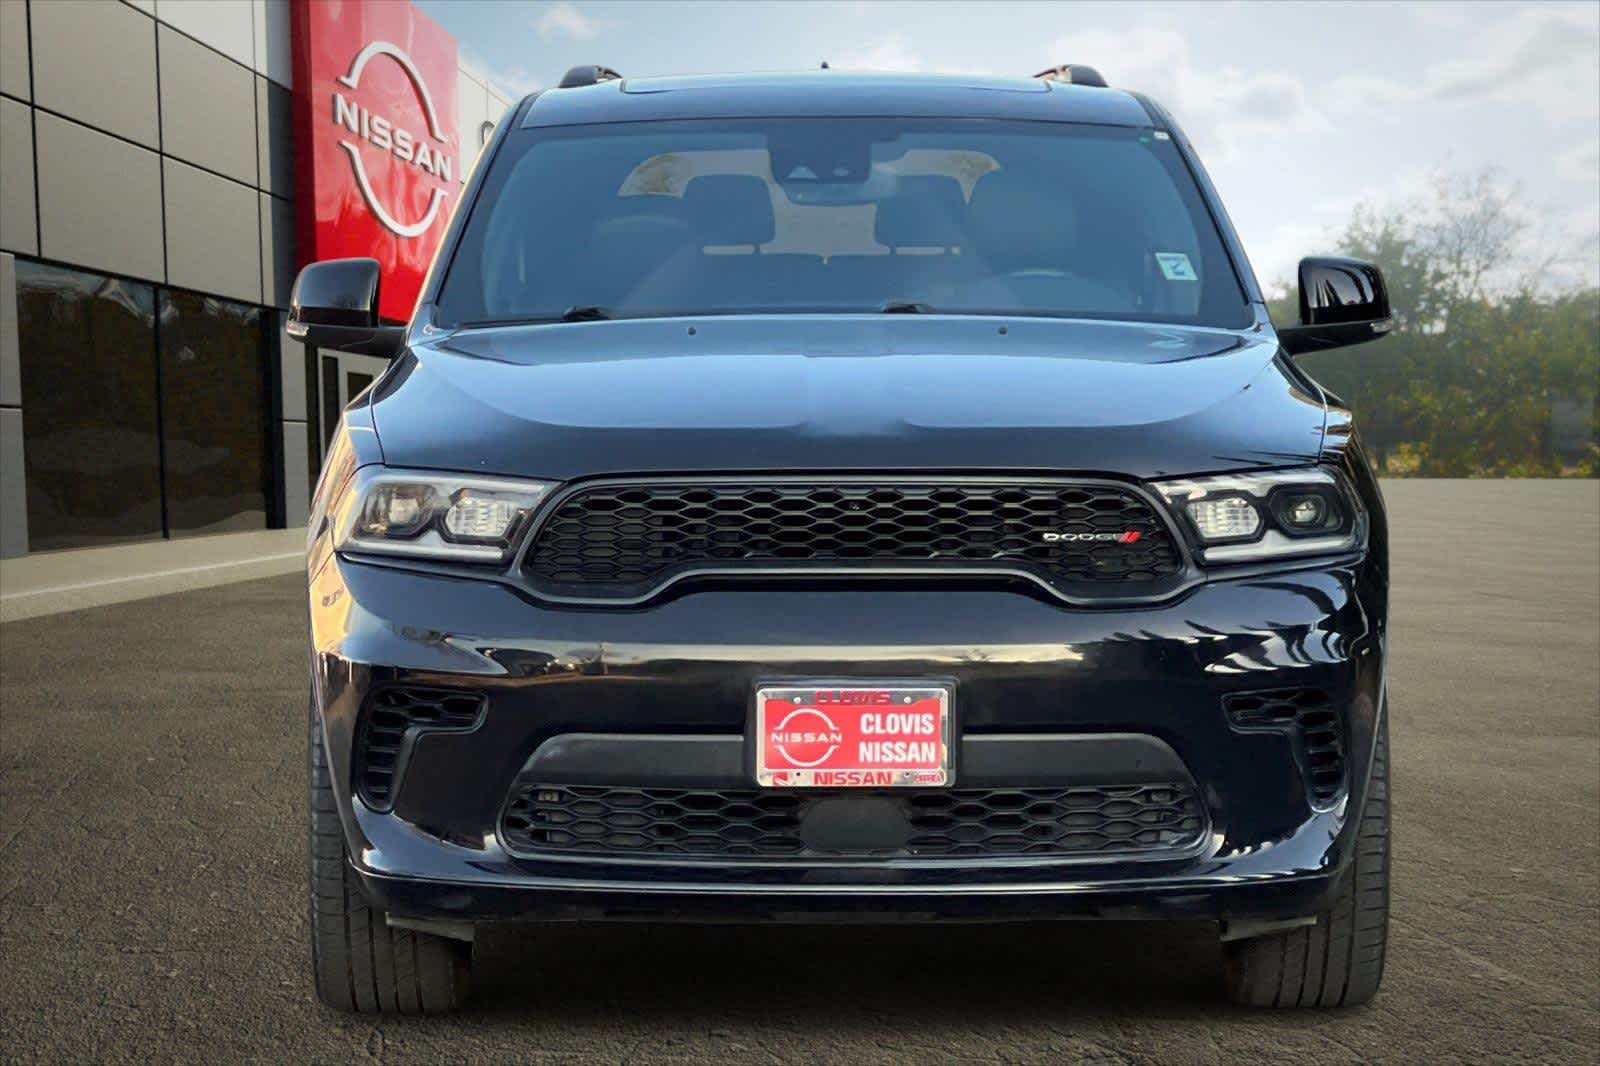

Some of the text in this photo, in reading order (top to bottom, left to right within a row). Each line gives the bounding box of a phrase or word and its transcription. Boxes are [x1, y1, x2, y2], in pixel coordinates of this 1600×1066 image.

[333, 92, 452, 182] NISSAN
[860, 713, 935, 734] CLOVIS
[771, 732, 842, 743] NISSAN
[859, 741, 936, 763] NISSAN
[814, 771, 893, 785] NISSAN
